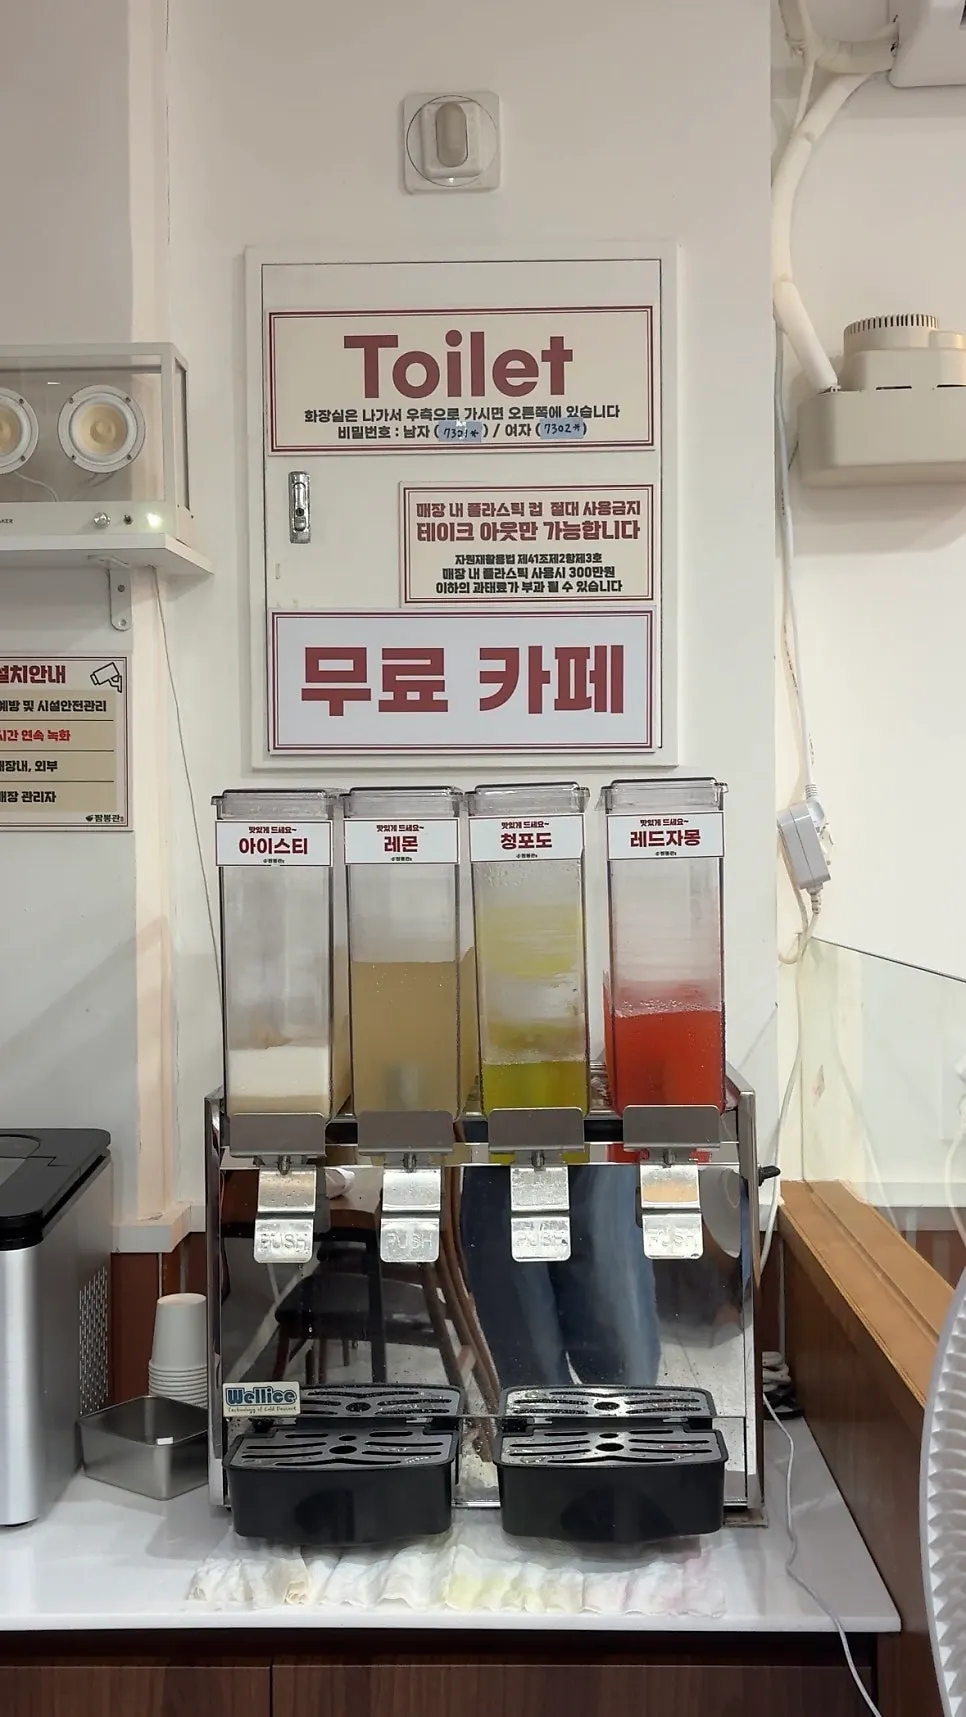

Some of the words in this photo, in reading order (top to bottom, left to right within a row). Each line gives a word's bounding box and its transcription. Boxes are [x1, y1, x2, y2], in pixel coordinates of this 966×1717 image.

[344, 330, 573, 399] Toilet
[305, 409, 357, 423] 화장실은
[362, 408, 402, 422] 나가서
[407, 408, 459, 421] 우측으로
[464, 407, 504, 421] 가시면
[508, 406, 562, 420] 오른쪽에
[567, 405, 620, 419] 있습니다
[338, 425, 391, 439] 비밀번호
[403, 424, 430, 439] 남자
[505, 423, 531, 438] 여자
[417, 503, 445, 518] 매장
[450, 503, 463, 517] 내
[468, 502, 524, 517] 플라스틱
[529, 502, 543, 517] 컵
[551, 501, 579, 516] 절대
[583, 501, 640, 516] 사용금지
[417, 522, 474, 542] 테이크
[480, 521, 538, 541] 아웃만
[543, 520, 640, 541] 가능합니다
[455, 554, 515, 565] 자원재활용법
[518, 553, 602, 564] 제41조제2항제3호
[443, 568, 465, 579] 매장
[469, 568, 479, 579] 내
[483, 568, 528, 579] 플라스틱
[532, 567, 565, 578] 사용시
[569, 566, 615, 578] 300만원
[436, 582, 469, 594] 이하의
[473, 581, 518, 593] 과태료가
[522, 581, 544, 593] 부과
[548, 581, 558, 593] 될
[562, 581, 573, 593] 수
[577, 580, 622, 592] 있습니다
[301, 646, 448, 717] 무료
[479, 644, 624, 714] 카페
[23, 700, 34, 712] 및
[38, 700, 106, 712] 시설안전관리
[21, 730, 44, 742] 연속
[48, 730, 70, 742] 녹화
[34, 760, 58, 772] 외부
[21, 791, 56, 802] 관리자
[376, 824, 398, 832] 맛있게
[501, 821, 522, 829] 맛있게
[640, 819, 661, 827] 맛있게
[239, 838, 308, 855] 아이스티
[384, 836, 418, 853] 레몬
[501, 833, 552, 849] 청포도
[630, 830, 701, 848] 레드자몽
[386, 1232, 432, 1250] PUSH
[226, 1386, 297, 1406] Wellice
